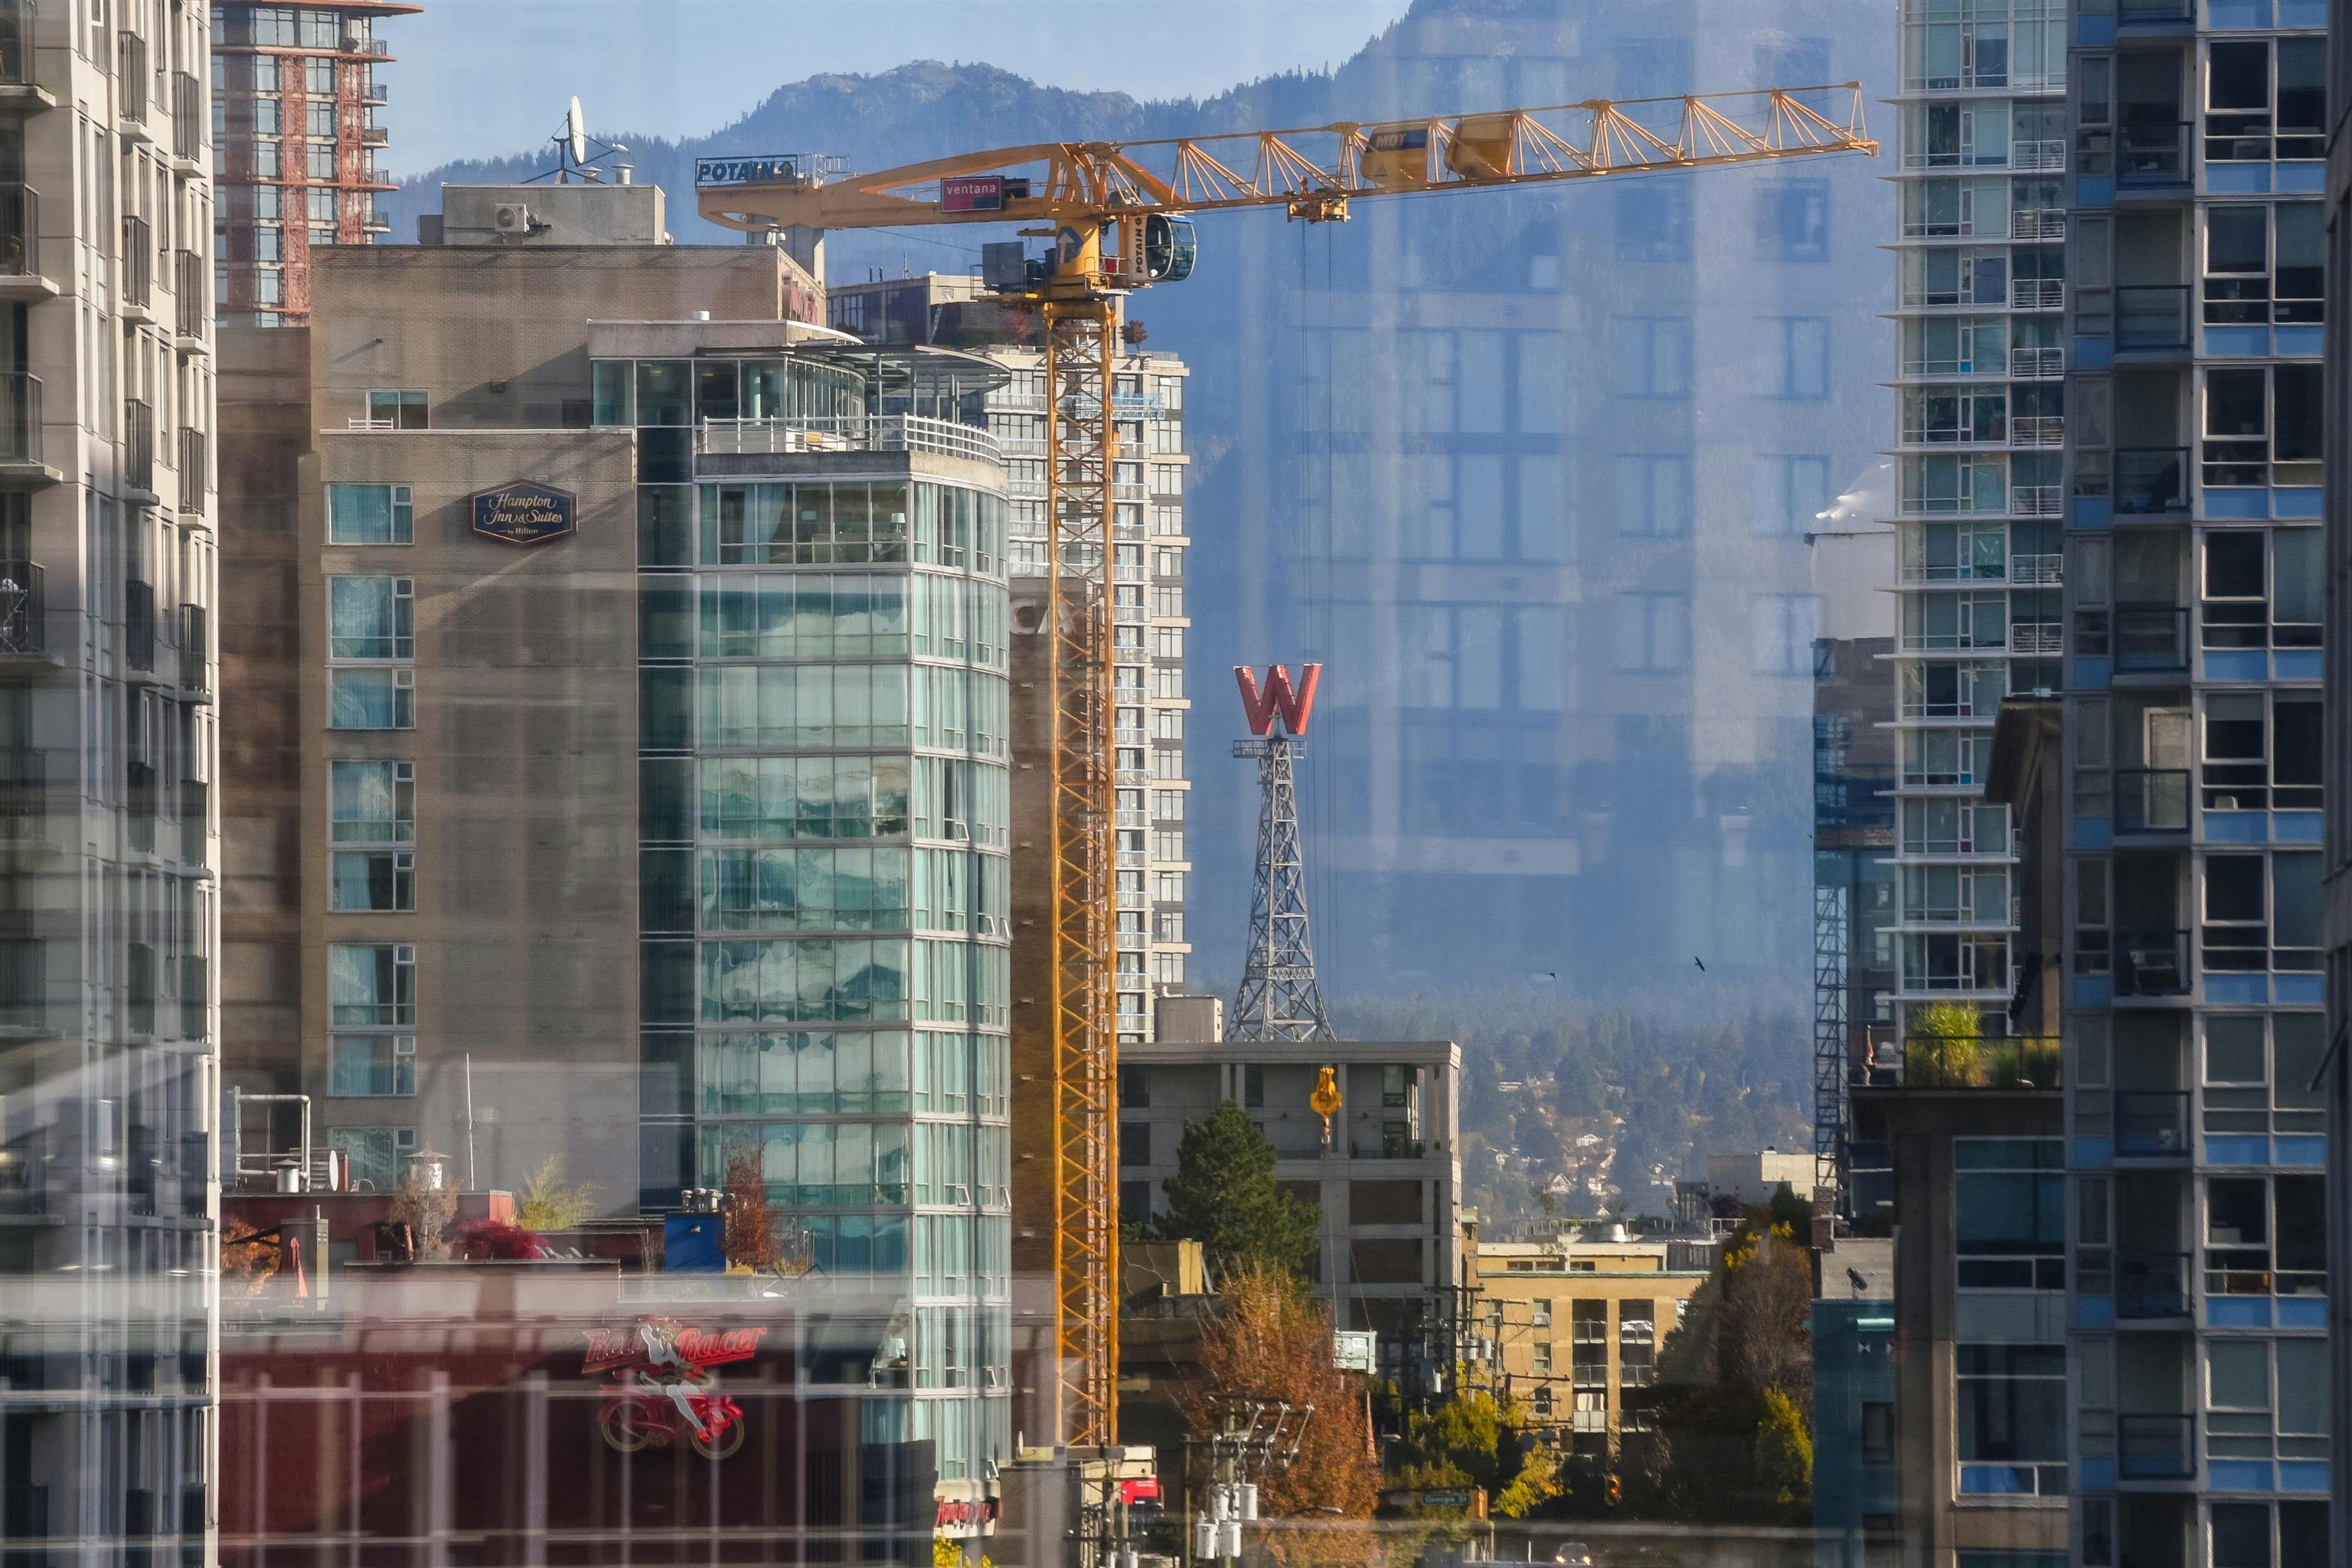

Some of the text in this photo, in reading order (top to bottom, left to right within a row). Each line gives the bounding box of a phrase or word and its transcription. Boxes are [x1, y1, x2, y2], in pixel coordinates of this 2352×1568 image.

[1377, 134, 1406, 147] MDT
[697, 161, 776, 182] POTAIN
[946, 184, 996, 194] ventana
[1135, 228, 1144, 273] POTAIN
[488, 493, 557, 510] Hampton
[525, 510, 564, 524] Suites
[1233, 663, 1323, 736] W
[675, 1326, 768, 1361] Racer
